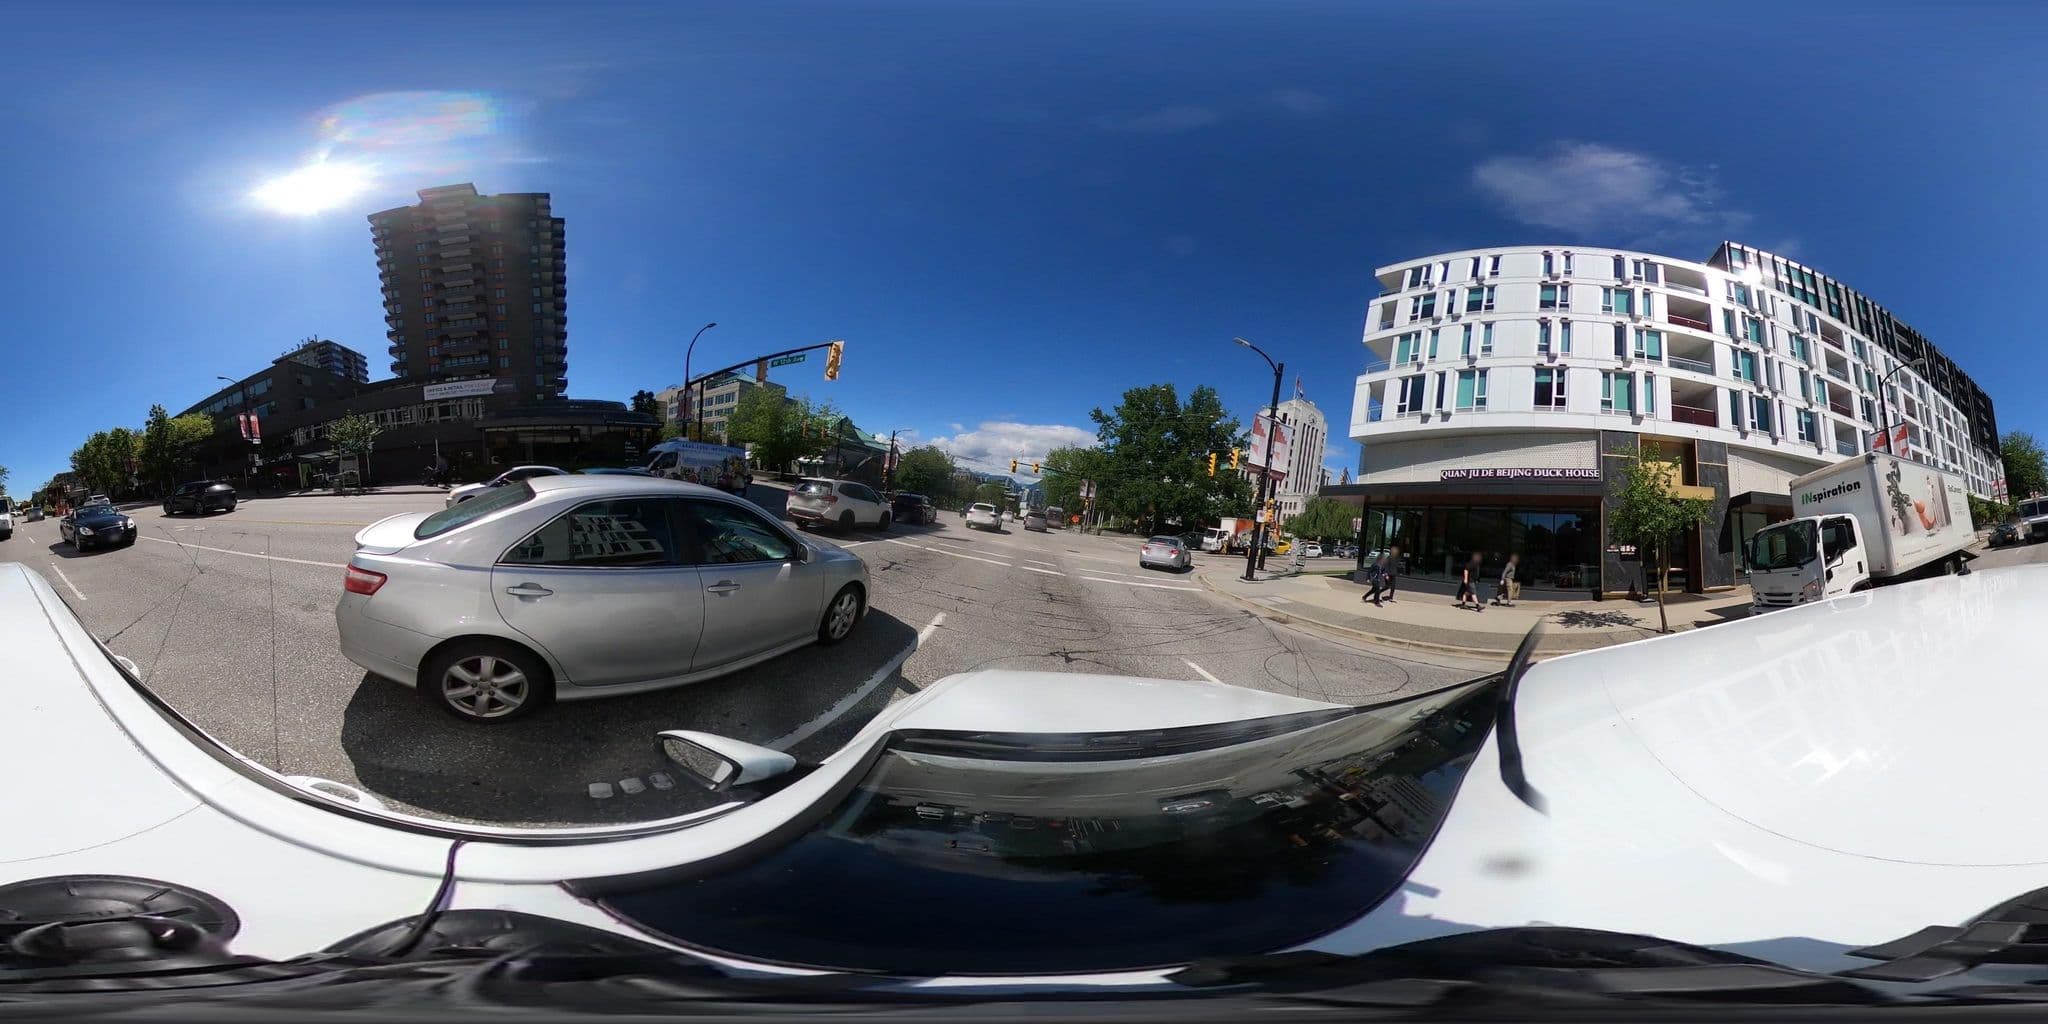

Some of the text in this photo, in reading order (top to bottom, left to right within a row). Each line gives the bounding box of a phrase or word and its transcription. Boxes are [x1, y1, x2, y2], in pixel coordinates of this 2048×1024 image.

[1441, 468, 1600, 479] QUAN JU DE BEIJING DUCK HOUSE
[1801, 481, 1861, 504] INspiration
